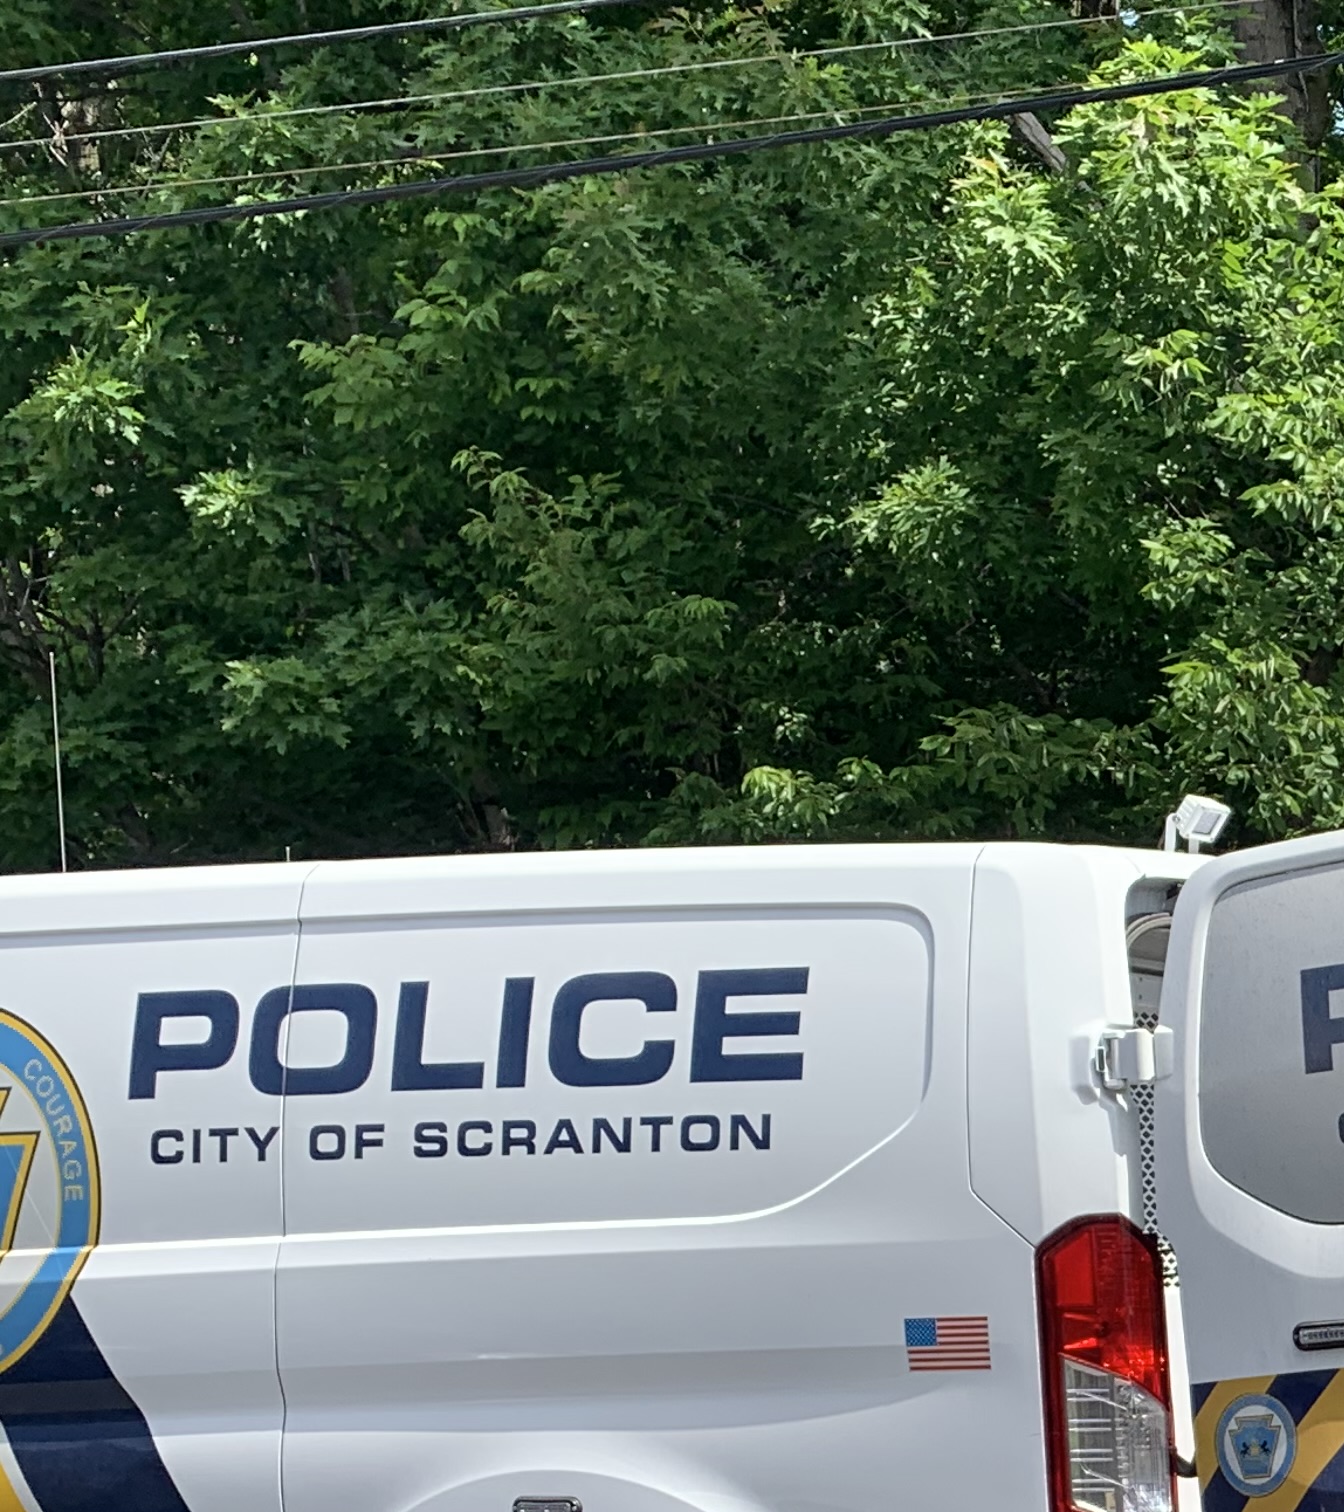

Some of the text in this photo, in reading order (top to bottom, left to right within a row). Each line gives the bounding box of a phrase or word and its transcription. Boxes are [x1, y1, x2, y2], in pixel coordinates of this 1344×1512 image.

[128, 967, 810, 1100] POLICE
[24, 1058, 84, 1202] COURAGE
[150, 1114, 771, 1165] CITY OF SCRANTON
